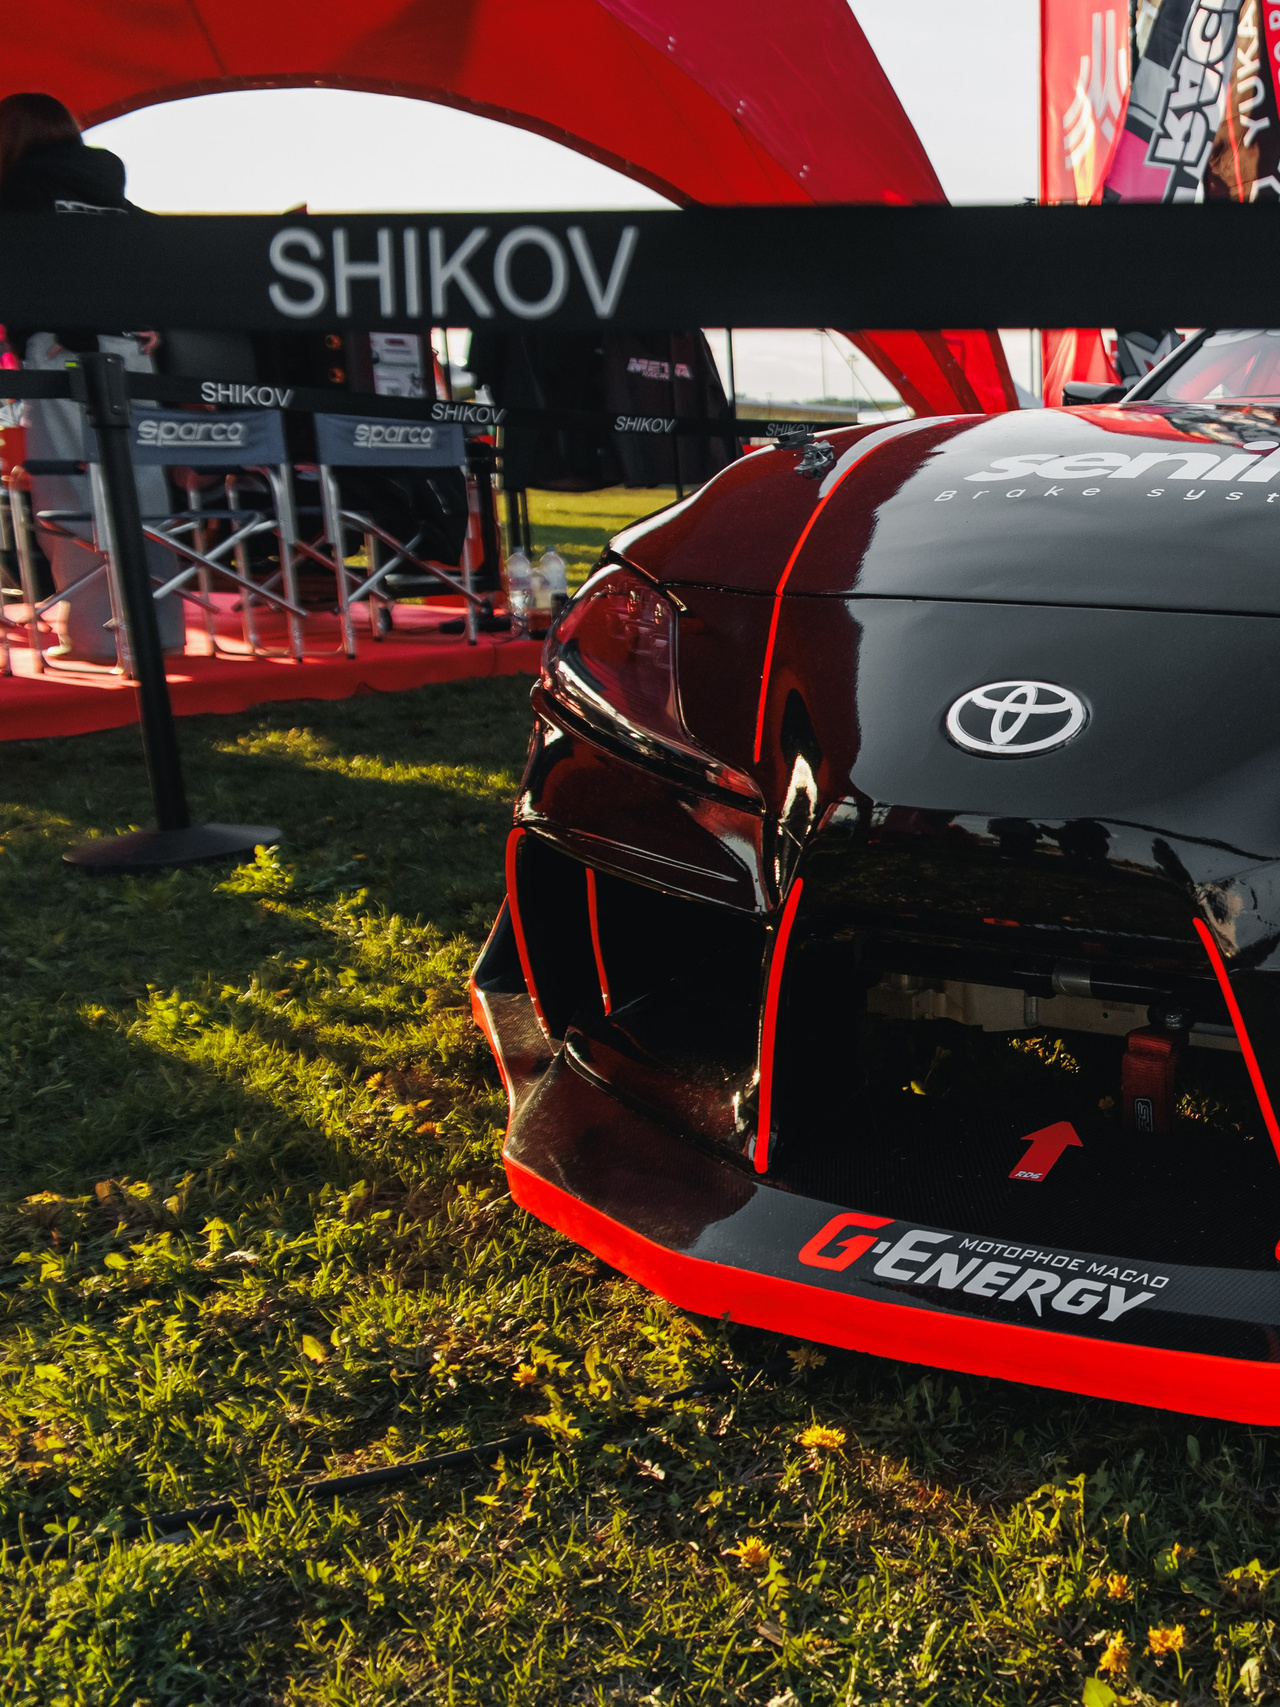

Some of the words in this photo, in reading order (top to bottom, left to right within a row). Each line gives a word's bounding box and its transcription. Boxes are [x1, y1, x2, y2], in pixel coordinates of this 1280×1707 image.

[267, 224, 640, 320] SHIKOV
[200, 381, 294, 408] SHIKOV
[431, 402, 505, 425] SHIKOV
[614, 415, 677, 434] SHIKOV
[136, 418, 248, 447] sparco
[353, 423, 434, 449] sparco
[934, 484, 1102, 502] Brake
[1014, 1170, 1044, 1181] RDS
[958, 1237, 1086, 1272] МОТОРНОЕ
[1085, 1262, 1170, 1289] МАСЛО
